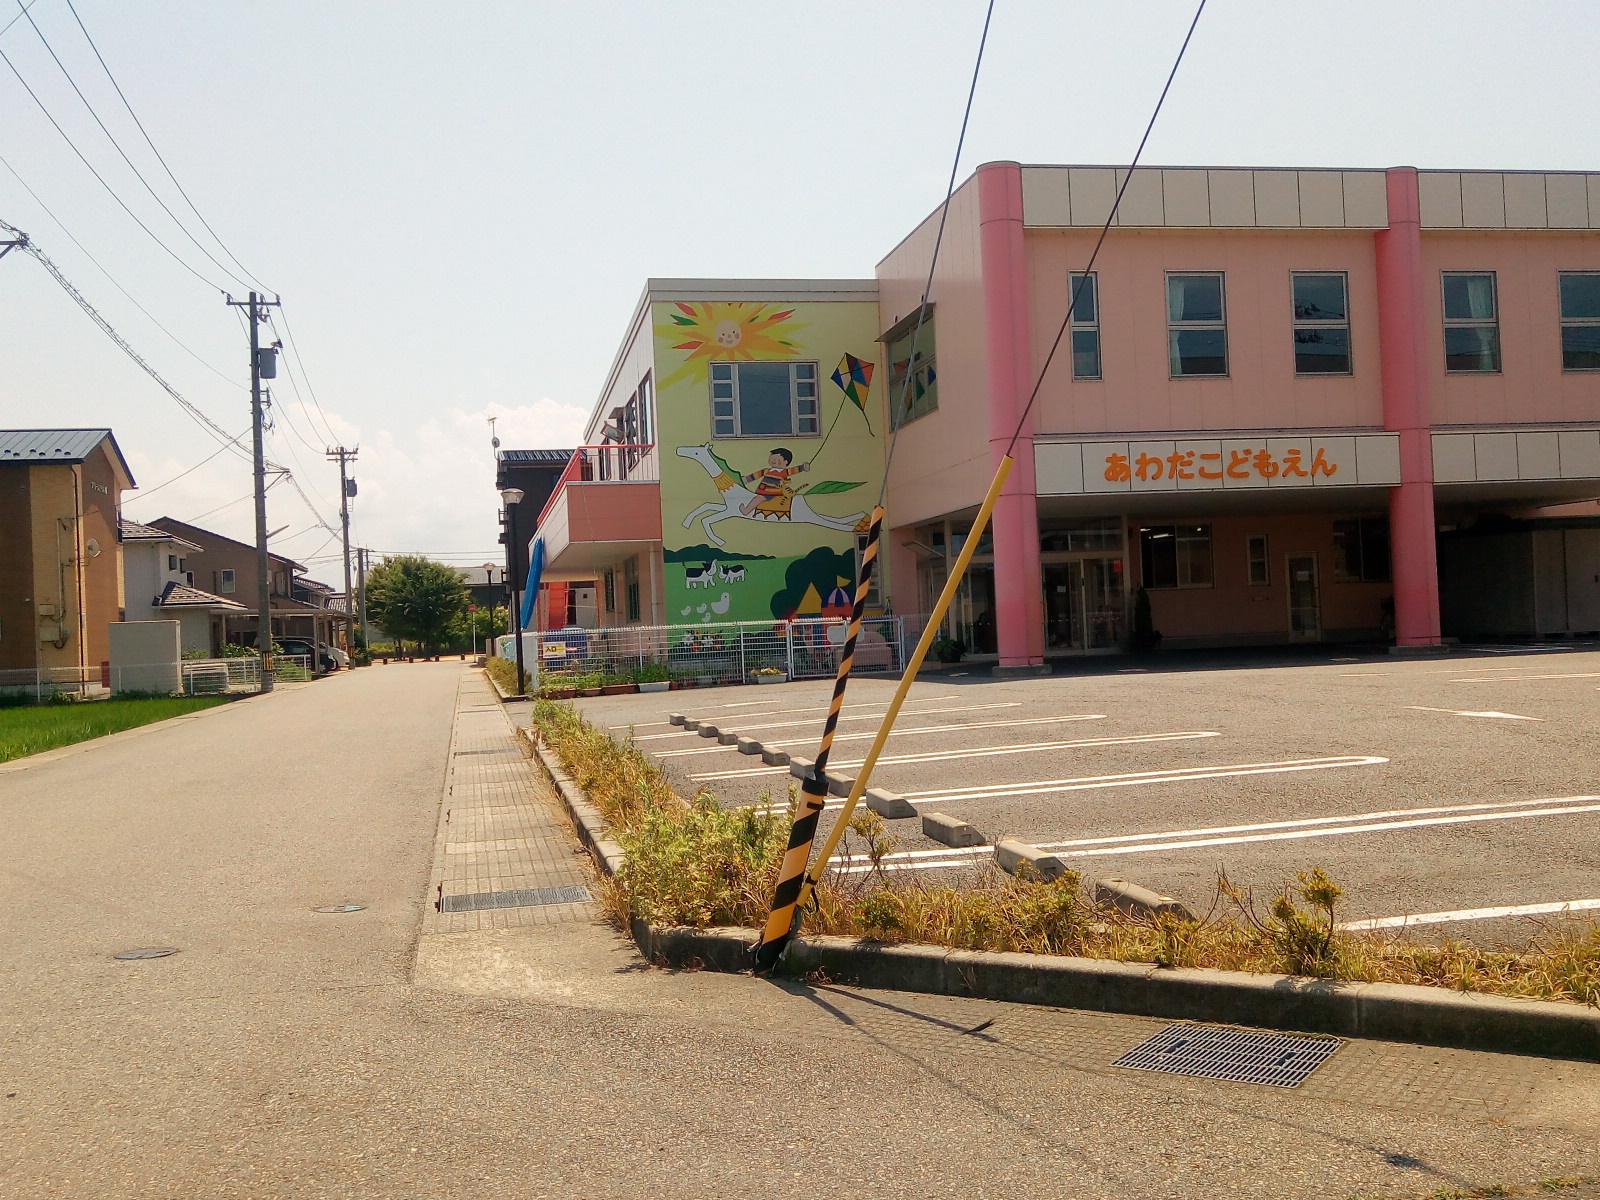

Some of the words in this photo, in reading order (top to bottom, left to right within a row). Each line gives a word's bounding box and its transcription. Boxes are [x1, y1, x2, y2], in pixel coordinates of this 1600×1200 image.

[1104, 448, 1337, 481] あわだこどもえん
